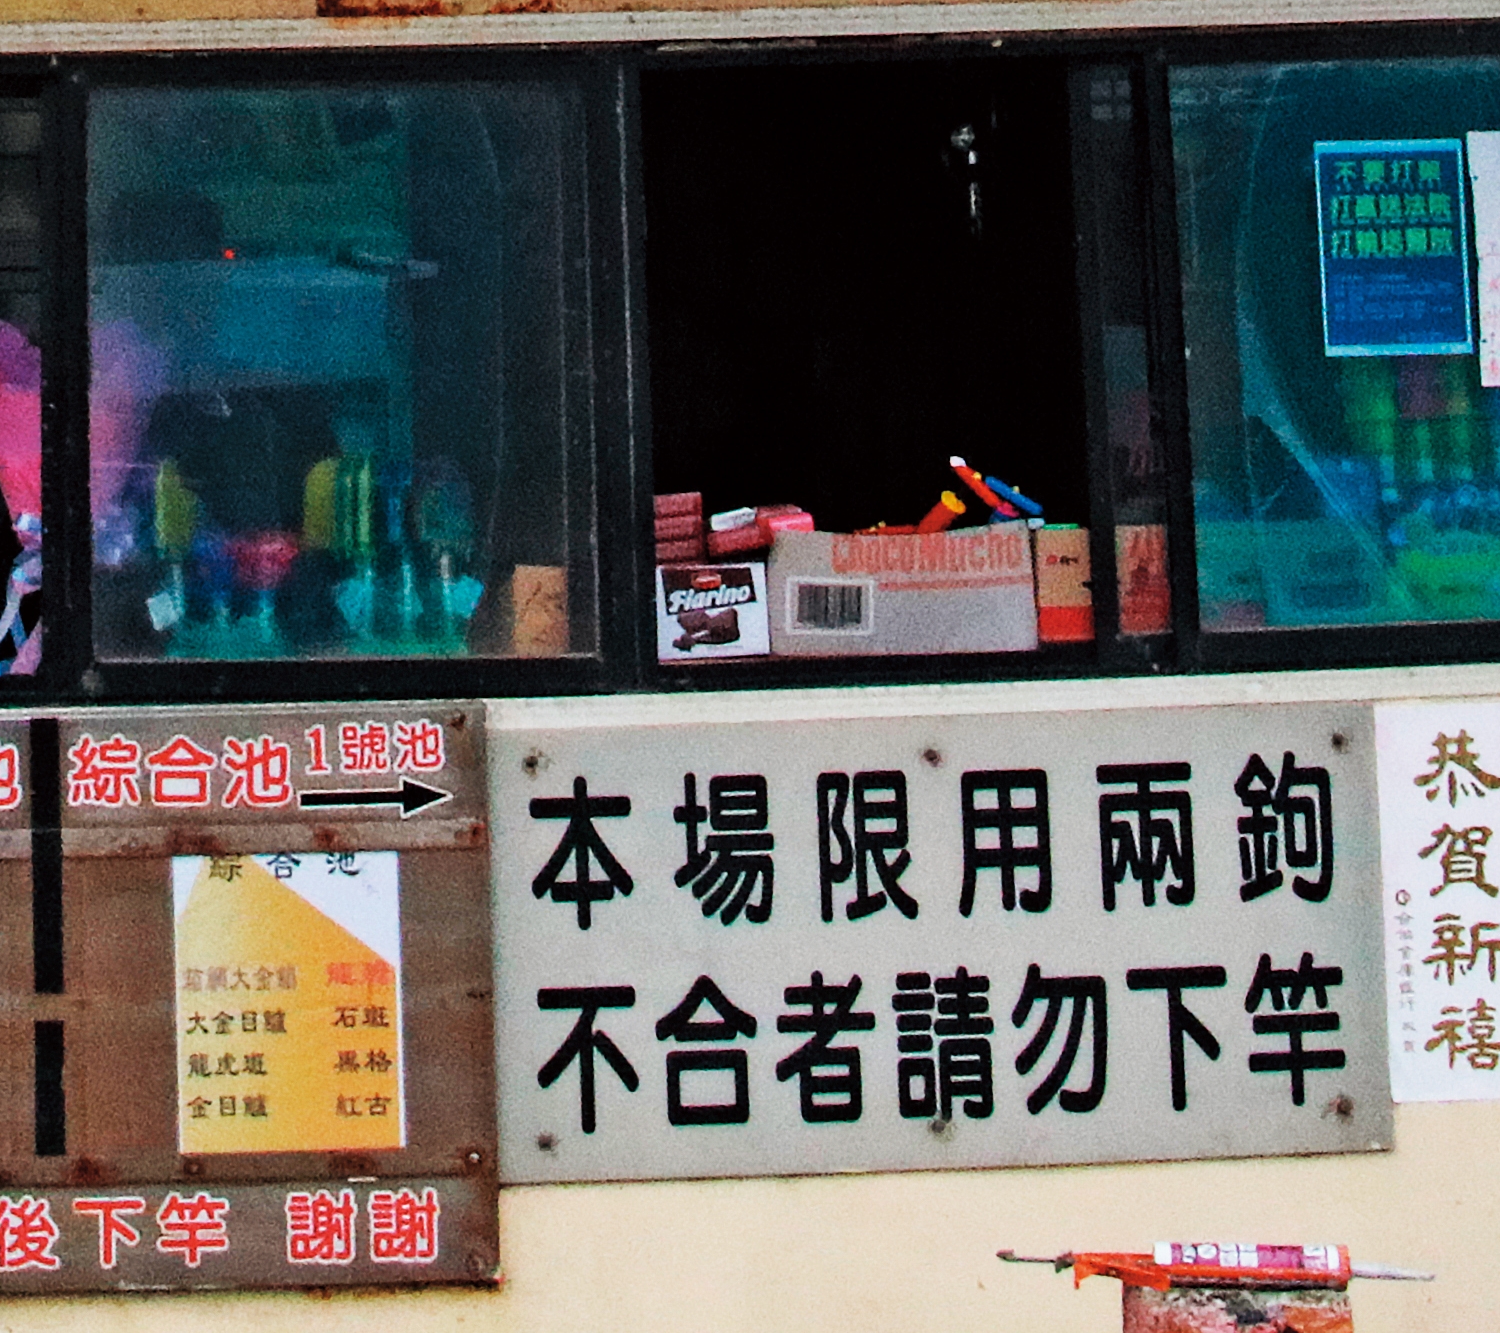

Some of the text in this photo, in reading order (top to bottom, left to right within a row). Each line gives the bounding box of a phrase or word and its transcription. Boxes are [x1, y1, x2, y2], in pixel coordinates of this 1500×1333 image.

[68, 721, 445, 810] 綜合池 1號池
[529, 751, 1336, 931] 本場限用兩鉤
[535, 952, 1347, 1136] 不合者請勿下竿
[284, 1189, 441, 1265] 謝謝
